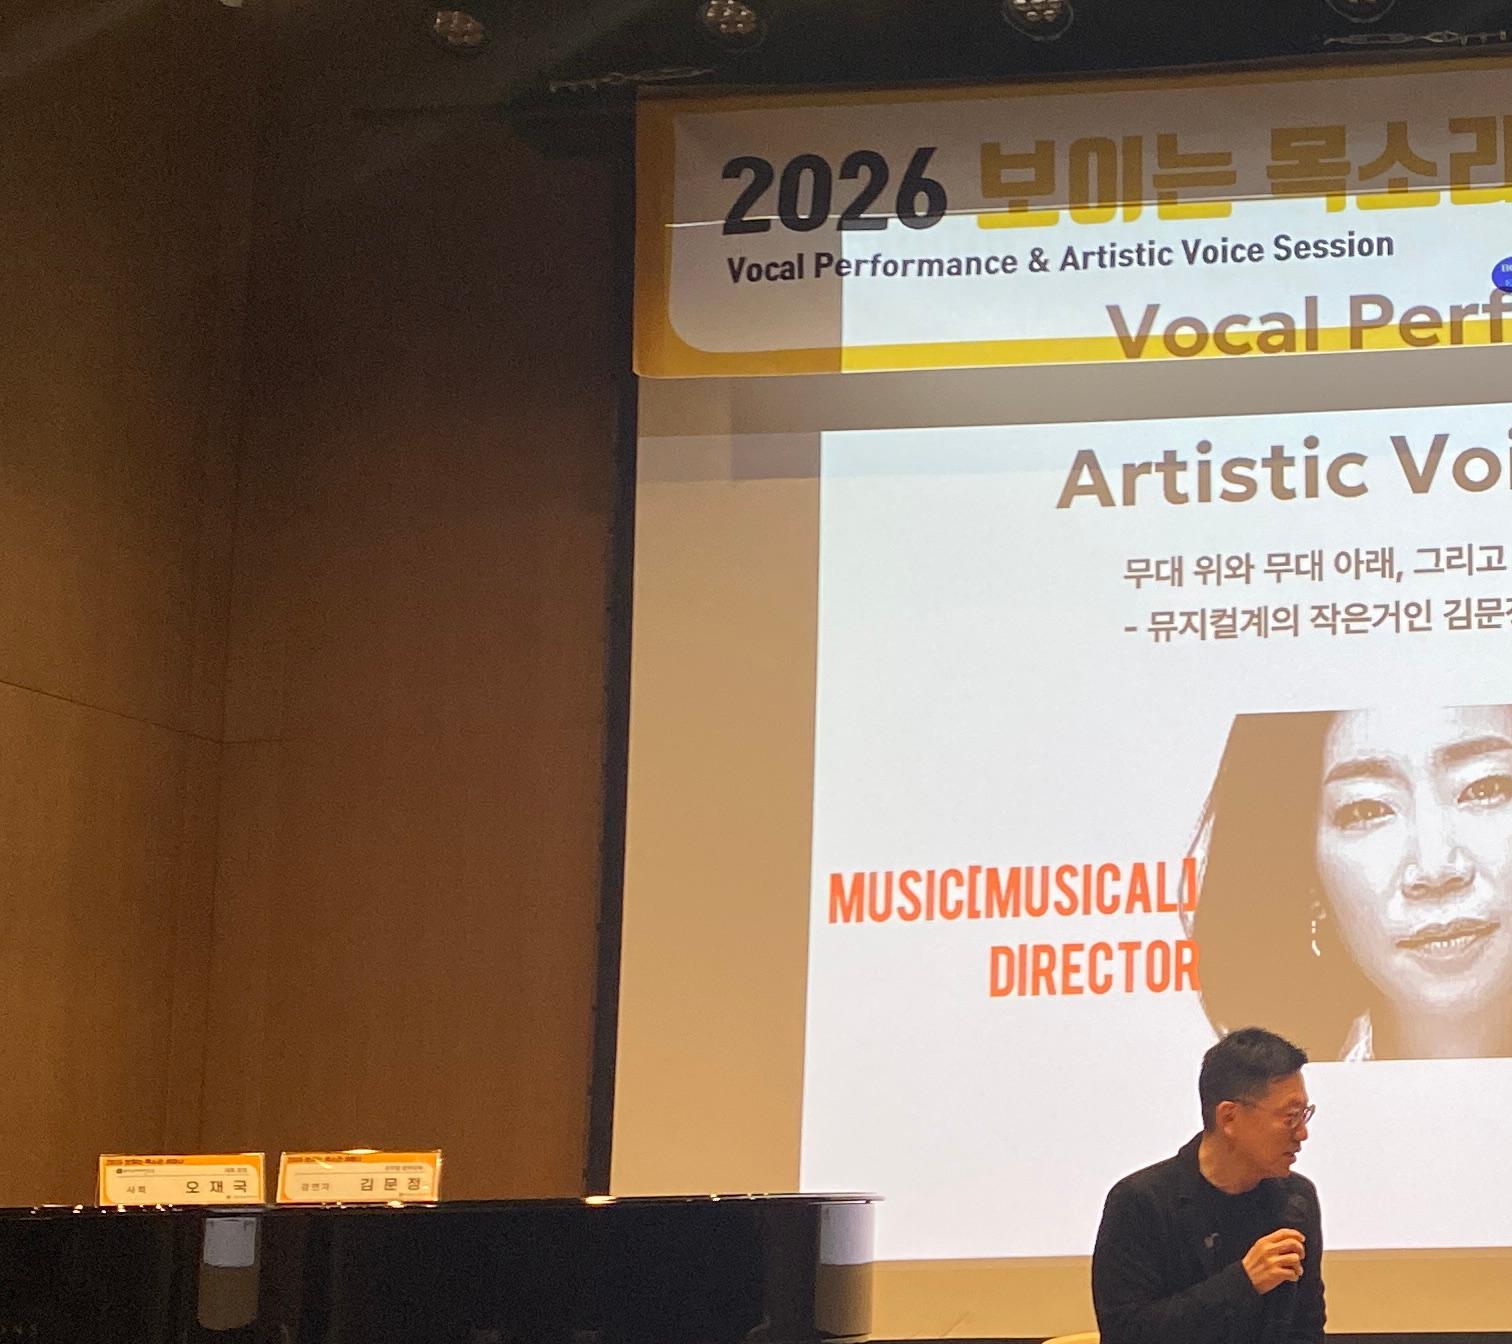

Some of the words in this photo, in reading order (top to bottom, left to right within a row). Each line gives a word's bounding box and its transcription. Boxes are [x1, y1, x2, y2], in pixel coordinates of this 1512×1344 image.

[722, 147, 947, 235] 2026
[976, 133, 1236, 230] 보이는
[727, 253, 804, 284] Vocal
[815, 250, 1018, 281] Performance
[1028, 247, 1051, 273] &
[1059, 239, 1174, 271] Artistic
[1181, 236, 1265, 266] Voice
[1273, 231, 1394, 260] Session
[1105, 295, 1319, 360] Vocal
[1056, 434, 1369, 510] Artistic
[1124, 555, 1185, 589] 무대
[1194, 552, 1255, 586] 위와
[1264, 549, 1324, 584] 무대
[1334, 546, 1404, 584] 아래,
[1414, 542, 1508, 576] 그리고
[1147, 604, 1300, 643] 뮤지컬계의
[1310, 599, 1433, 636] 작은거인
[988, 939, 1201, 998] DIRECTOR
